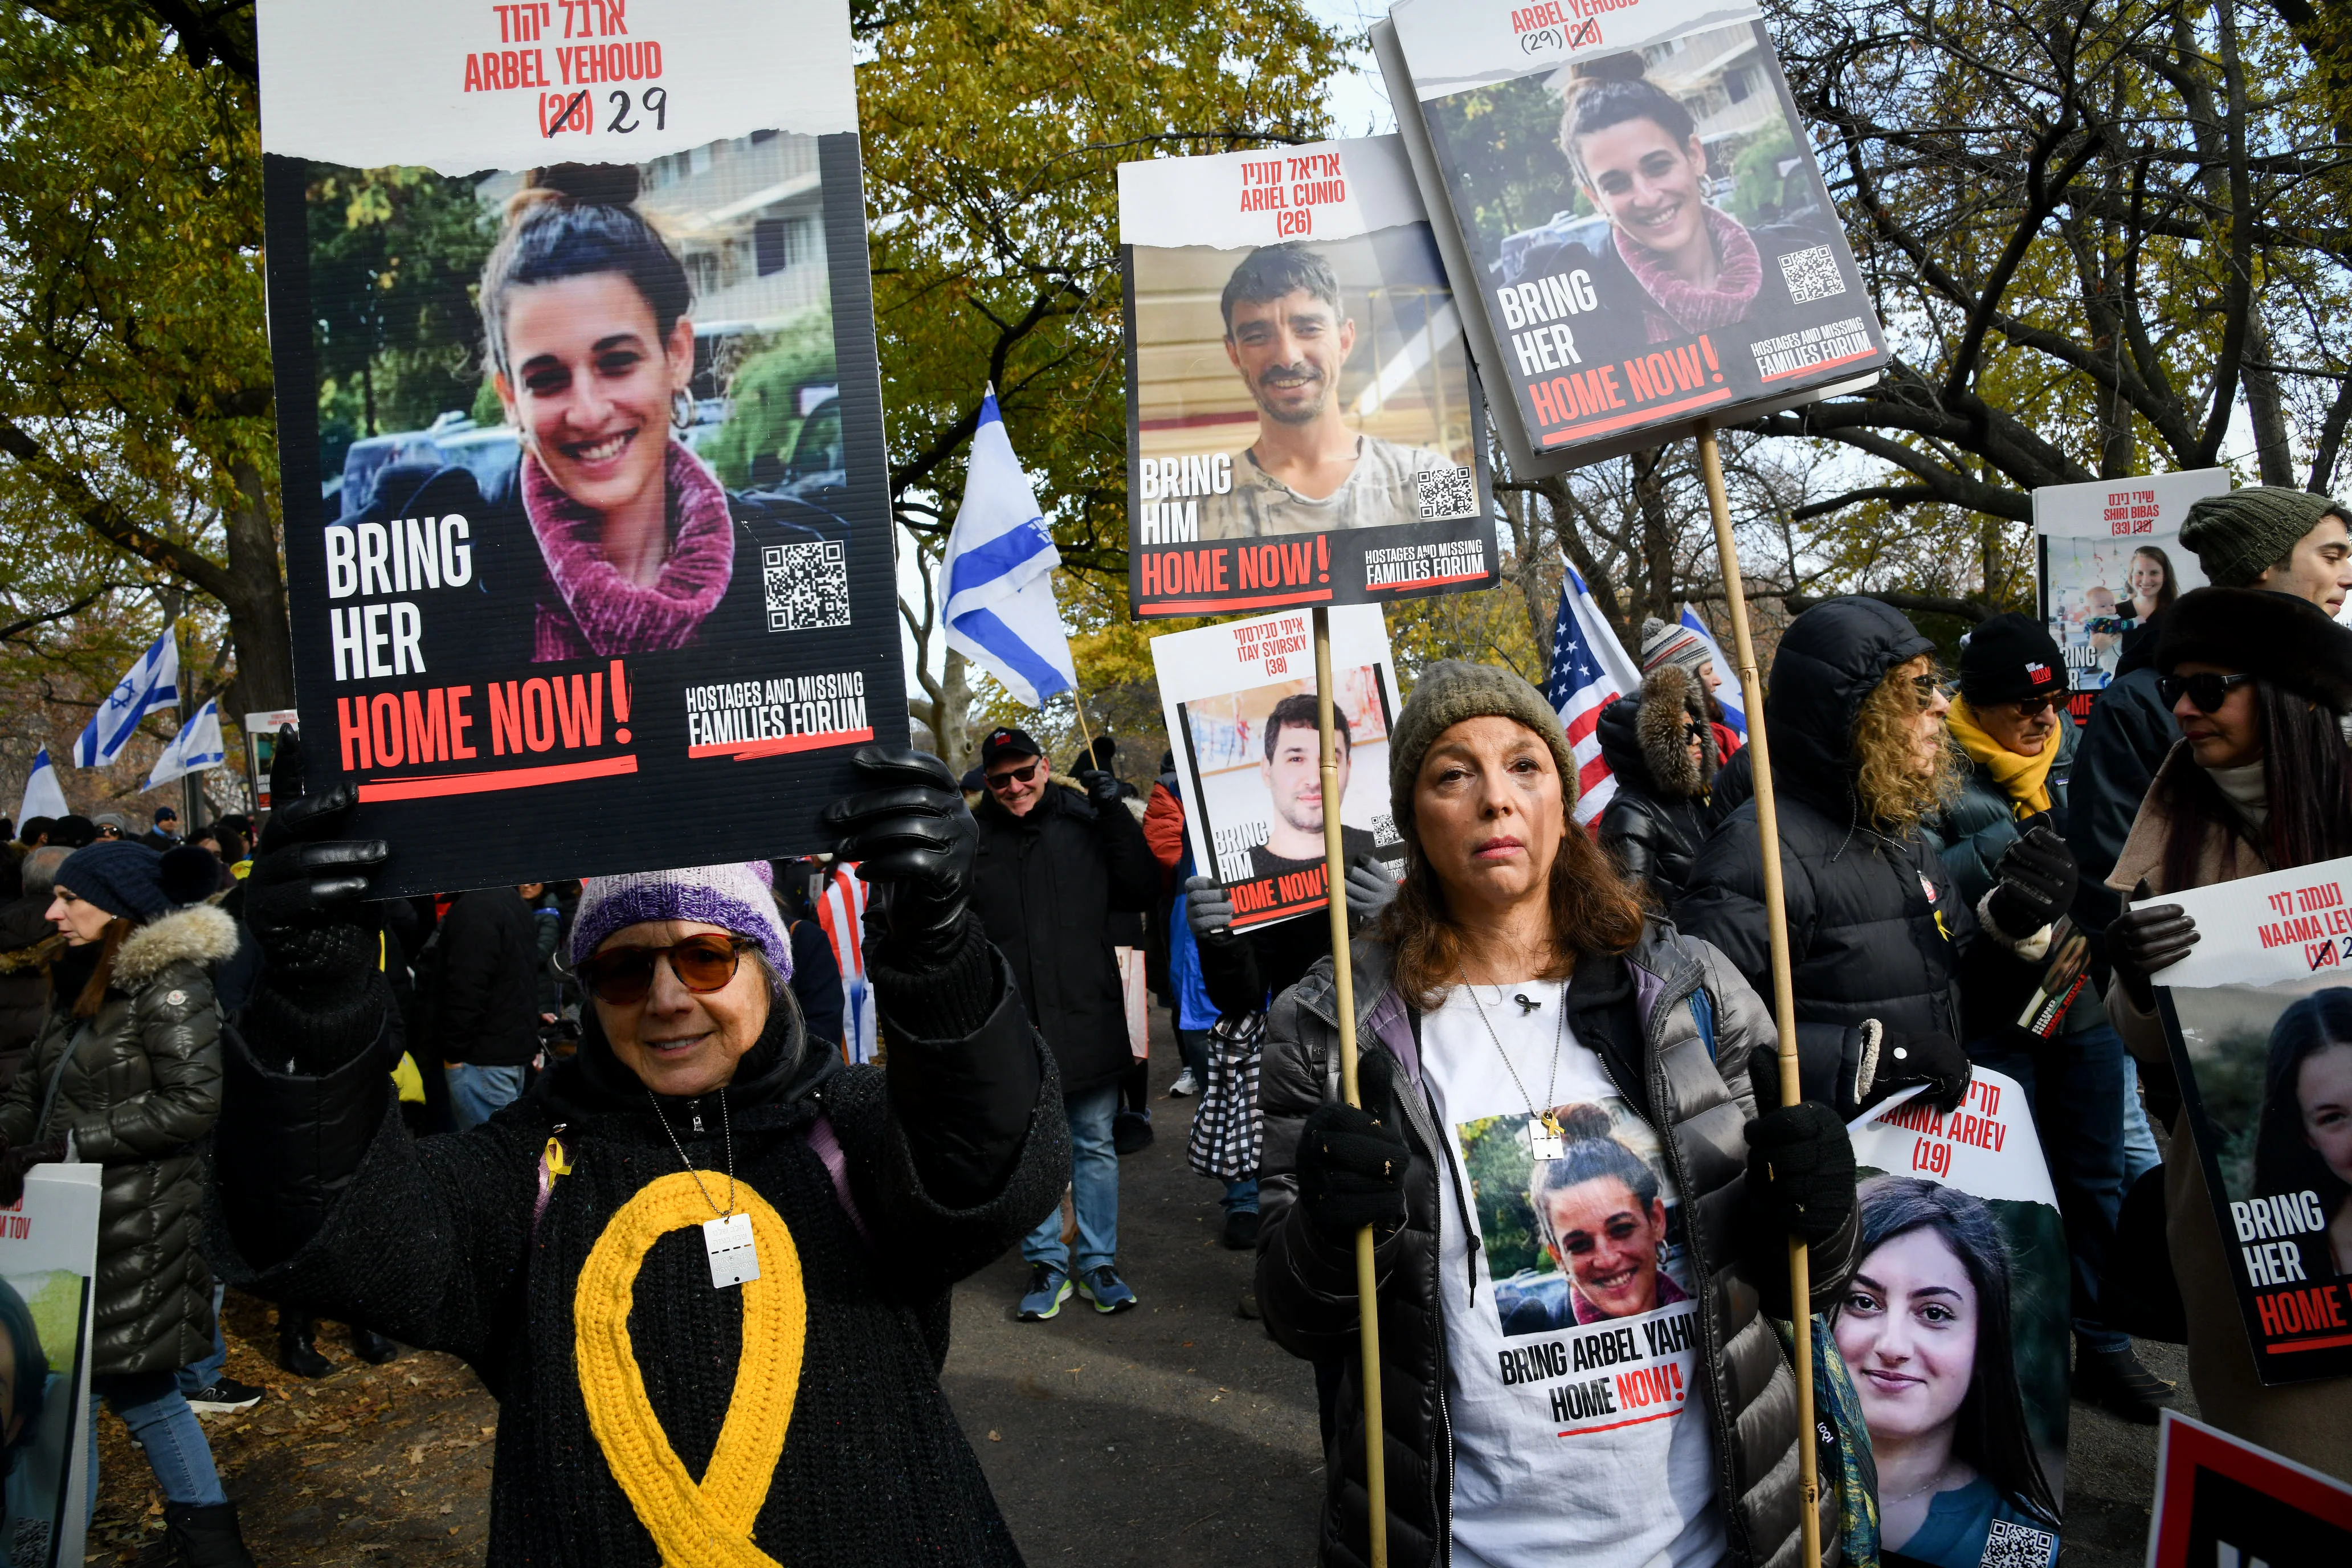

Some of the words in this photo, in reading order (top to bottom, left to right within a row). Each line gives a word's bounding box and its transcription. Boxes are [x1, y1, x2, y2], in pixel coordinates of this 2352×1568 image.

[493, 2, 550, 43] יהוד
[558, 0, 628, 38] ארבל
[1511, 1, 1569, 34] ARBEL
[1521, 29, 1562, 55] (29)
[464, 49, 550, 92] ARBEL
[556, 42, 663, 85] YEHOUD
[607, 87, 666, 133] 29
[1241, 161, 1281, 185] קוניו
[1287, 153, 1341, 181] אריאל
[1240, 186, 1289, 212] ARIEL
[1293, 179, 1345, 206] CUNIO
[1277, 208, 1312, 238] (26)
[1497, 269, 1598, 330] BRING
[1512, 324, 1582, 376] HER
[1750, 333, 1801, 357] HOSTAGES
[1800, 328, 1822, 345] AND
[1820, 317, 1865, 339] MISSING
[1755, 344, 1822, 377] FAMILIES
[1820, 330, 1873, 361] FORUM
[1528, 365, 1627, 426] HOME
[1623, 334, 1724, 402] NOW!
[1140, 452, 1231, 499] BRING
[2104, 507, 2128, 521] SHIRI
[2131, 504, 2159, 518] BIBAS
[2108, 492, 2130, 506] ביבס
[2133, 490, 2154, 504] שירי
[1141, 500, 1198, 545] HIM
[2112, 521, 2130, 536] (33)
[325, 514, 472, 598] BRING
[1141, 549, 1229, 596] HOME
[1238, 535, 1331, 589] NOW!
[1365, 546, 1415, 564] HOSTAGES
[1417, 544, 1436, 560] AND
[1439, 540, 1483, 557] MISSING
[1366, 560, 1430, 585] FAMILIES
[1433, 554, 1485, 578] FORUM
[330, 602, 426, 681] HER
[1233, 622, 1277, 646] סבירסקי
[1279, 617, 1305, 635] איתי
[1237, 644, 1259, 662] ITAY
[1262, 635, 1306, 657] SVIRSKY
[1265, 656, 1287, 676] (38)
[2059, 646, 2096, 667] RING
[685, 681, 761, 712] HOSTAGES
[766, 678, 795, 705] AND
[798, 671, 864, 702] MISSING
[337, 685, 477, 771] HOME
[488, 660, 633, 756] NOW!
[688, 705, 786, 747] FAMILIES
[790, 697, 868, 737] FORUM
[1214, 820, 1269, 855] BRING
[1220, 851, 1255, 884] HIM
[1227, 880, 1277, 914] HOME
[1280, 863, 1329, 903] NOW!
[2268, 891, 2293, 916] לוי
[2296, 882, 2343, 912] נעמה
[2258, 915, 2325, 949] NAAMA
[2032, 999, 2056, 1033] BRING
[2036, 1014, 2053, 1035] HIM
[1960, 1080, 2000, 1117] קרי
[1874, 1102, 1943, 1137] ARINA
[1947, 1112, 2006, 1152] ARIEV
[1913, 1137, 1951, 1178] (19)
[10, 1216, 31, 1239] TOV
[2230, 1190, 2325, 1242] BRING
[2242, 1241, 2306, 1287] HER
[2256, 1285, 2347, 1336] HOME
[1498, 1341, 1567, 1385] BRING
[1573, 1327, 1643, 1373] ARBEL
[1548, 1377, 1617, 1422] HOME
[1615, 1362, 1684, 1410] NOW!
